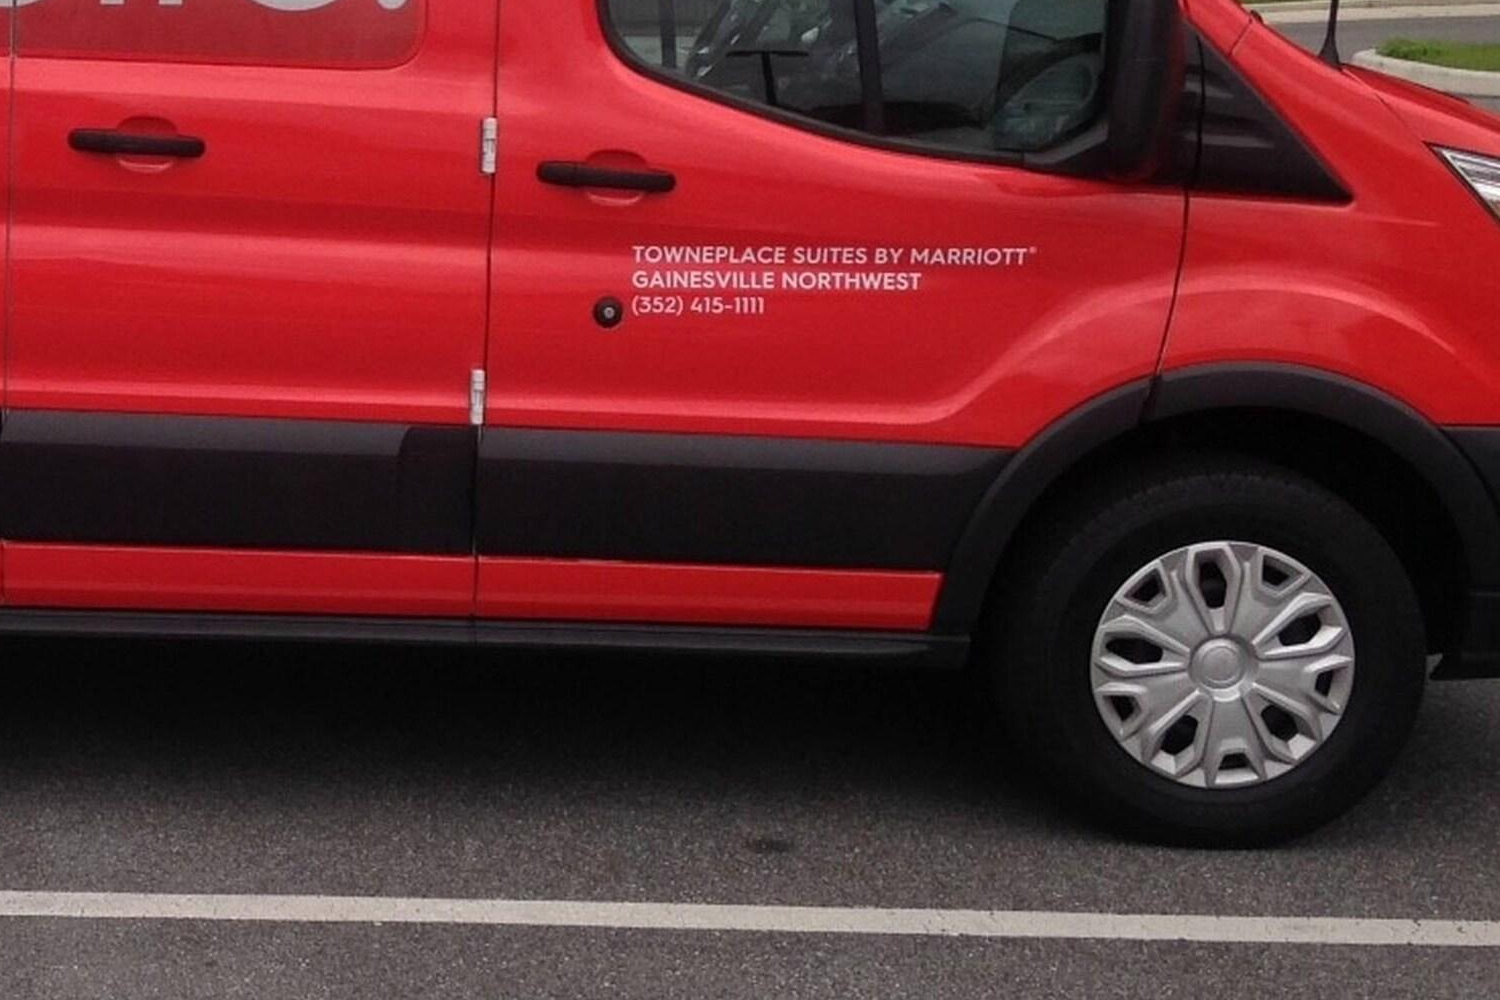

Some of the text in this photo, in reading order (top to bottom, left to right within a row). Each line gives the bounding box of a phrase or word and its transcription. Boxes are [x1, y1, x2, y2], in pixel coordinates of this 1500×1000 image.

[632, 245, 786, 264] TOWNEPLACE
[792, 246, 868, 265] SUITES
[874, 247, 904, 265] BY
[631, 271, 922, 291] GAINESVILLE NORTHWEST
[631, 296, 765, 316] (352) 415-1111
